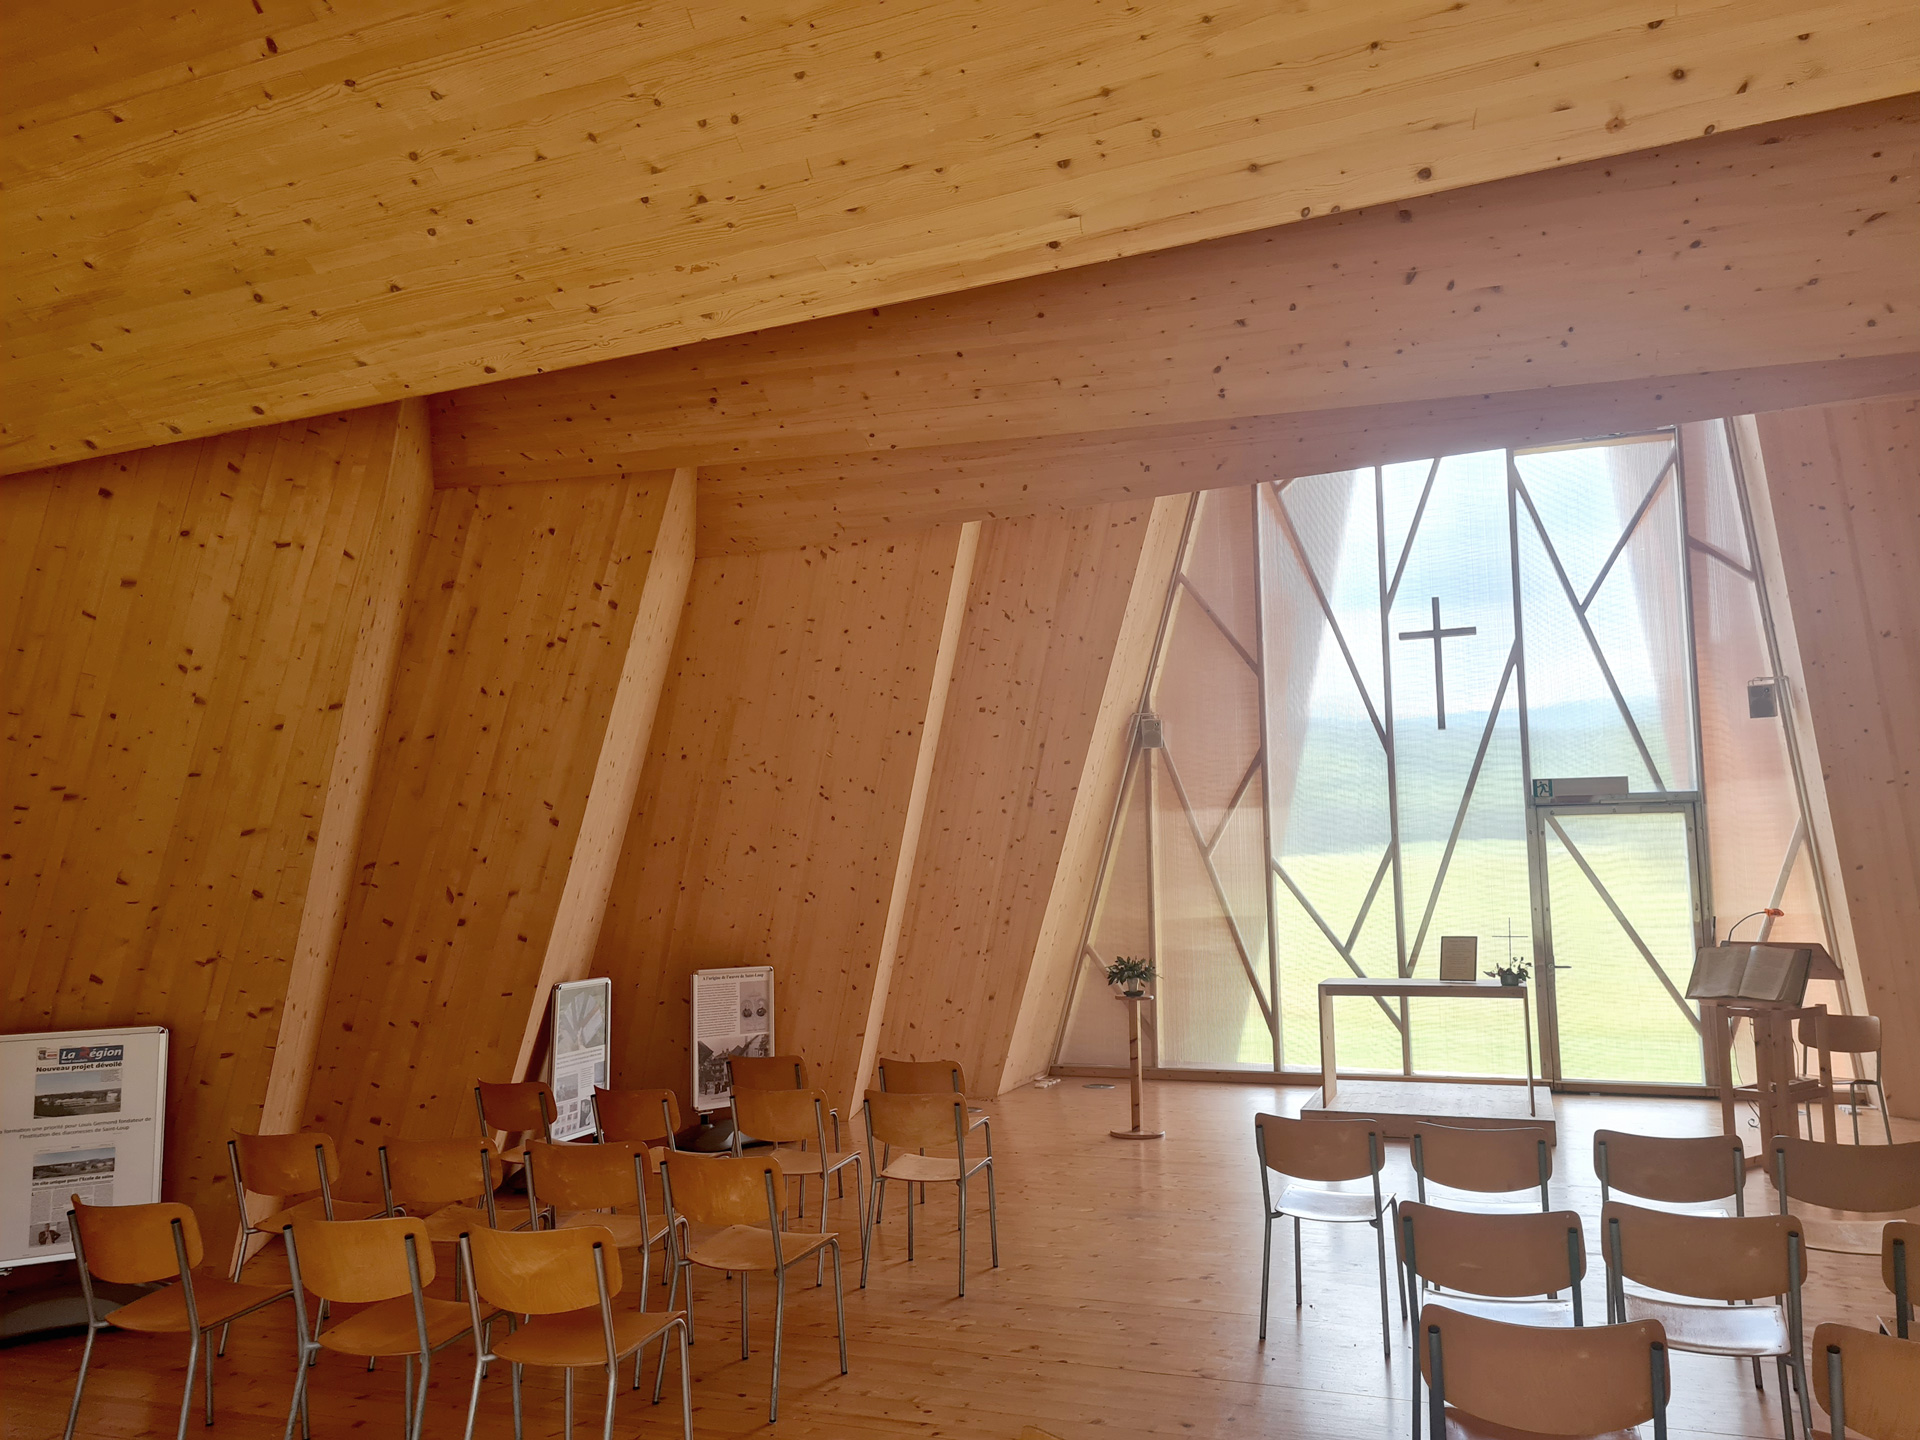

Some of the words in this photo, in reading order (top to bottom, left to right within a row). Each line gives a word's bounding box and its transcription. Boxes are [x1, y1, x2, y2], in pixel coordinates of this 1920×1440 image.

[62, 1051, 76, 1059] La
[80, 1046, 122, 1060] Région
[96, 1060, 122, 1068] dévoilé
